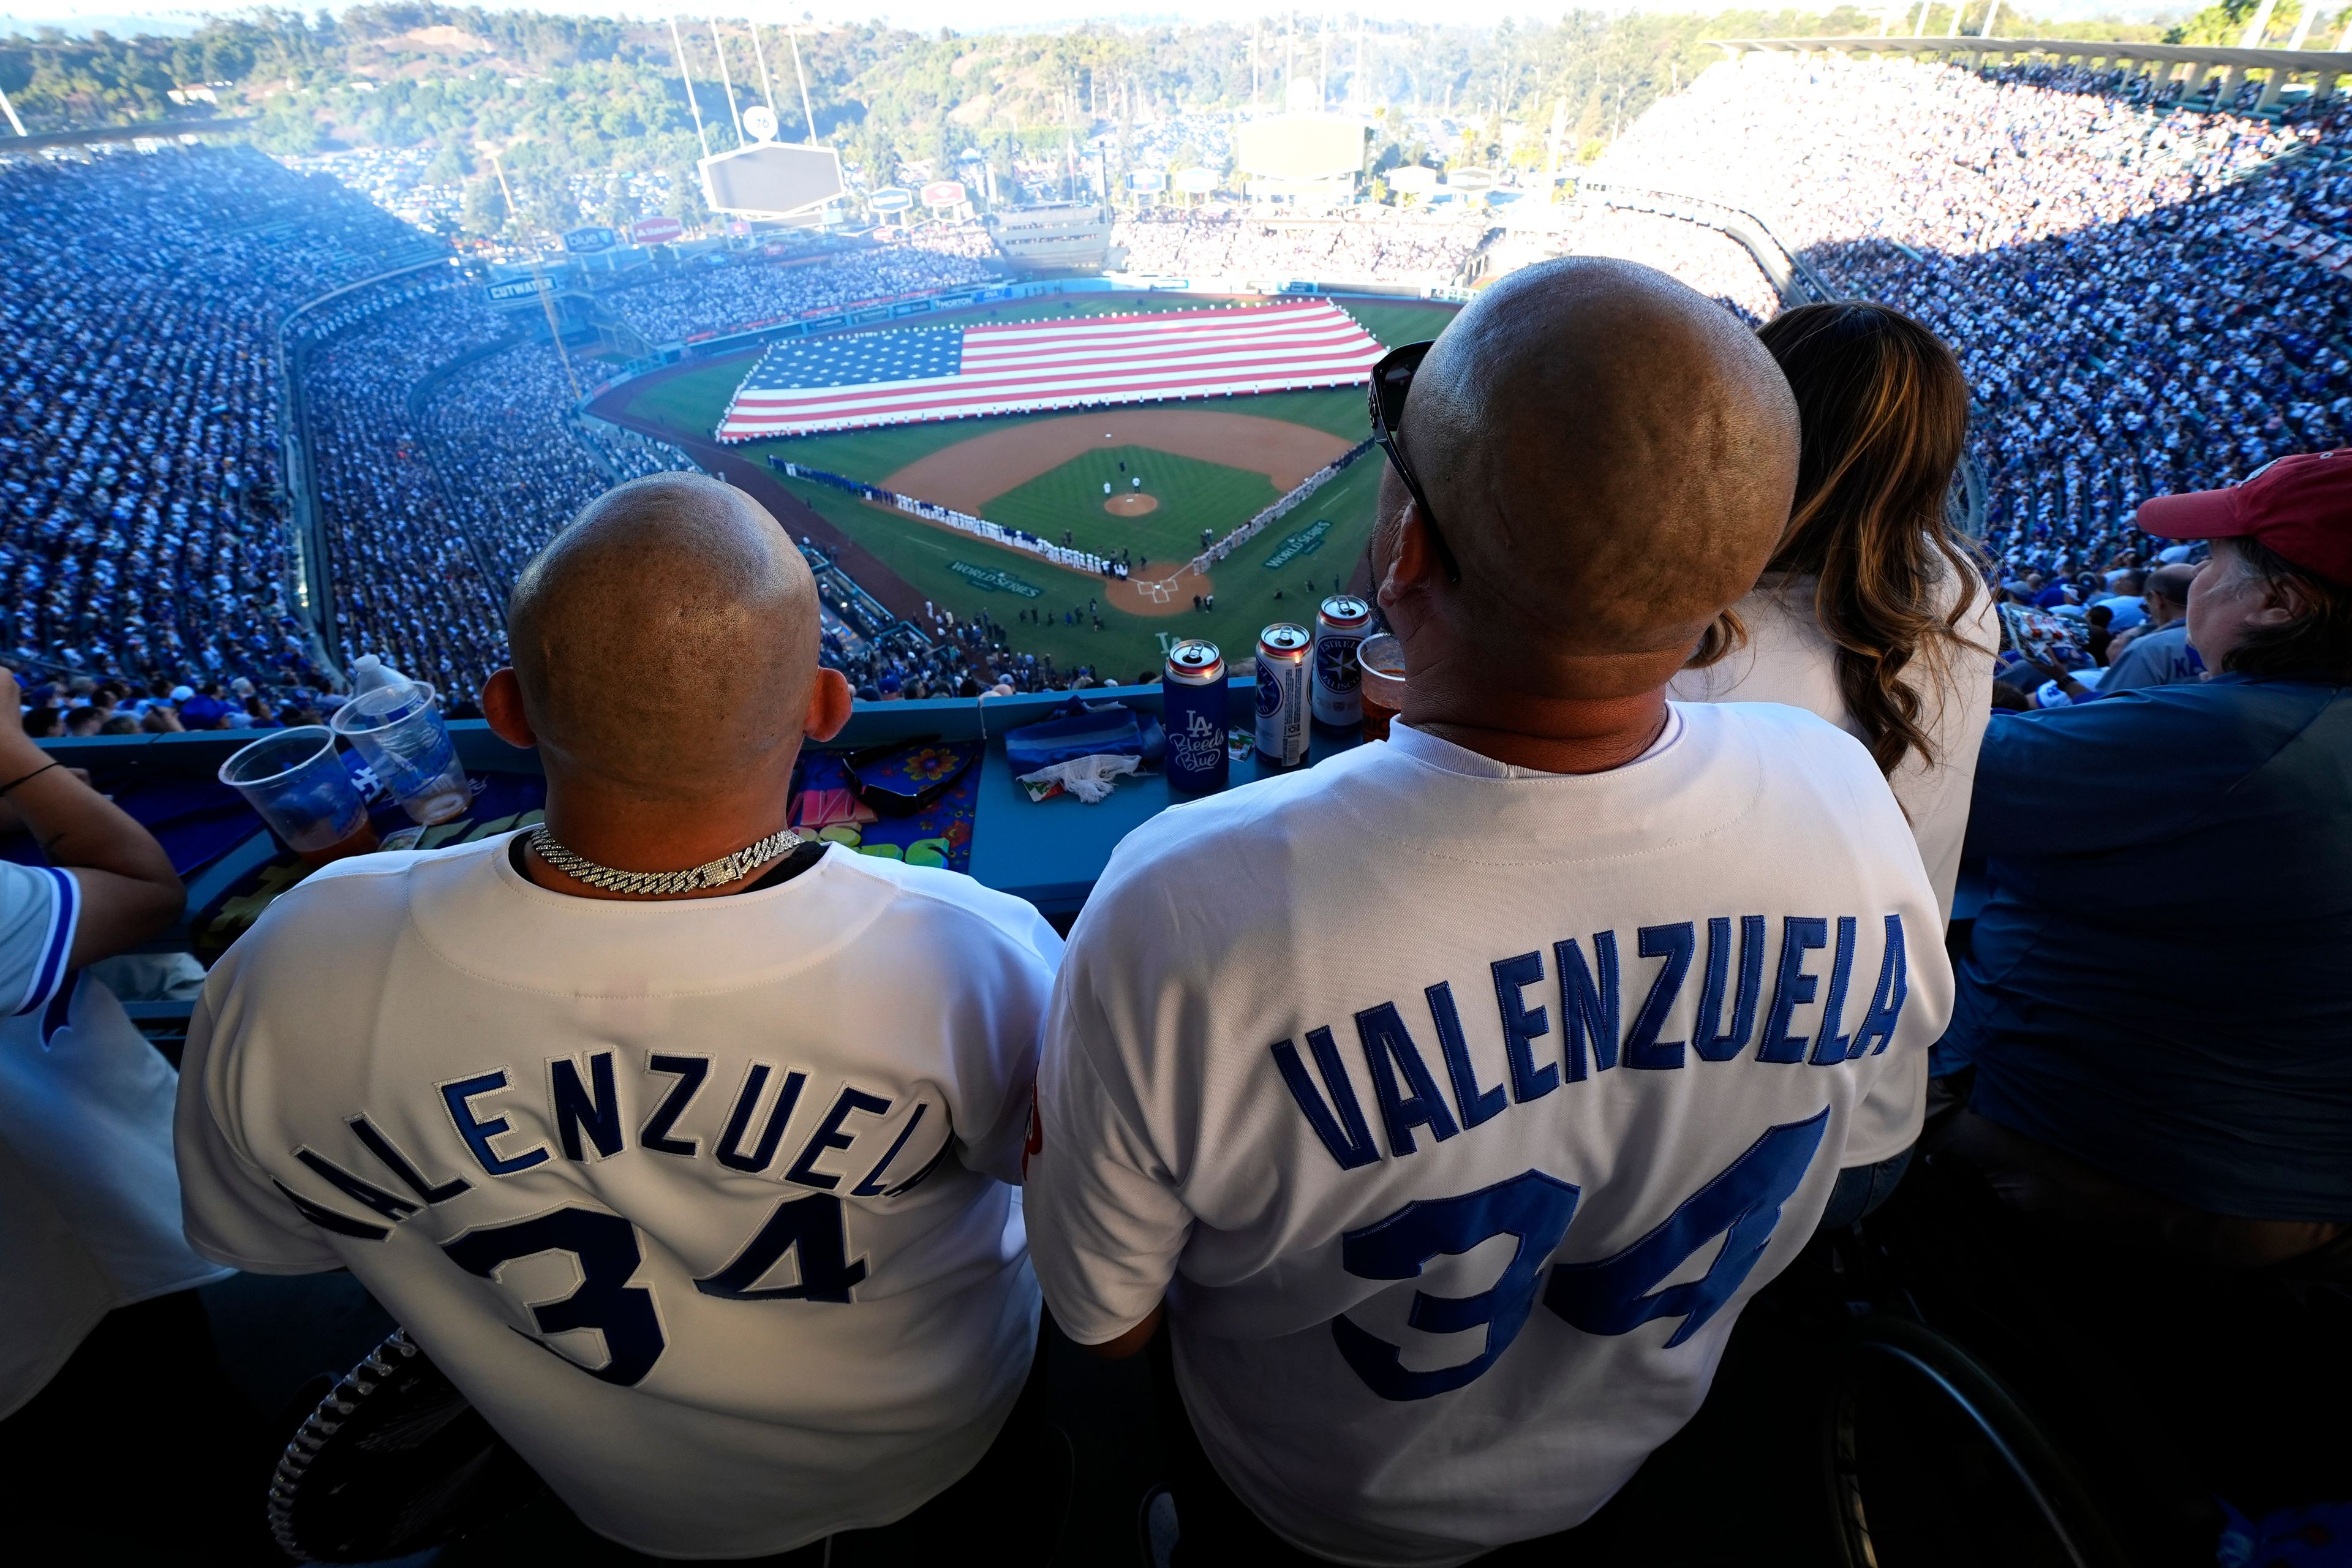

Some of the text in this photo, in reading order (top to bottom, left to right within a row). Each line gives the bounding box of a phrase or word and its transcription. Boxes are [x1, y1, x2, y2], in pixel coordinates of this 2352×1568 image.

[568, 233, 598, 246] blue
[1265, 542, 1303, 567] WORLD
[1297, 521, 1331, 544] SERIES
[951, 561, 997, 581] WORLD
[992, 578, 1040, 598] SERIES
[1321, 675, 1360, 690] JALISCO
[1186, 710, 1213, 737] LA
[1169, 728, 1225, 753] Bleeds
[1175, 748, 1221, 771] Blue
[1270, 914, 1907, 1170] VALENZUELA
[1332, 1104, 1831, 1401] 34
[437, 1198, 871, 1388] 34
